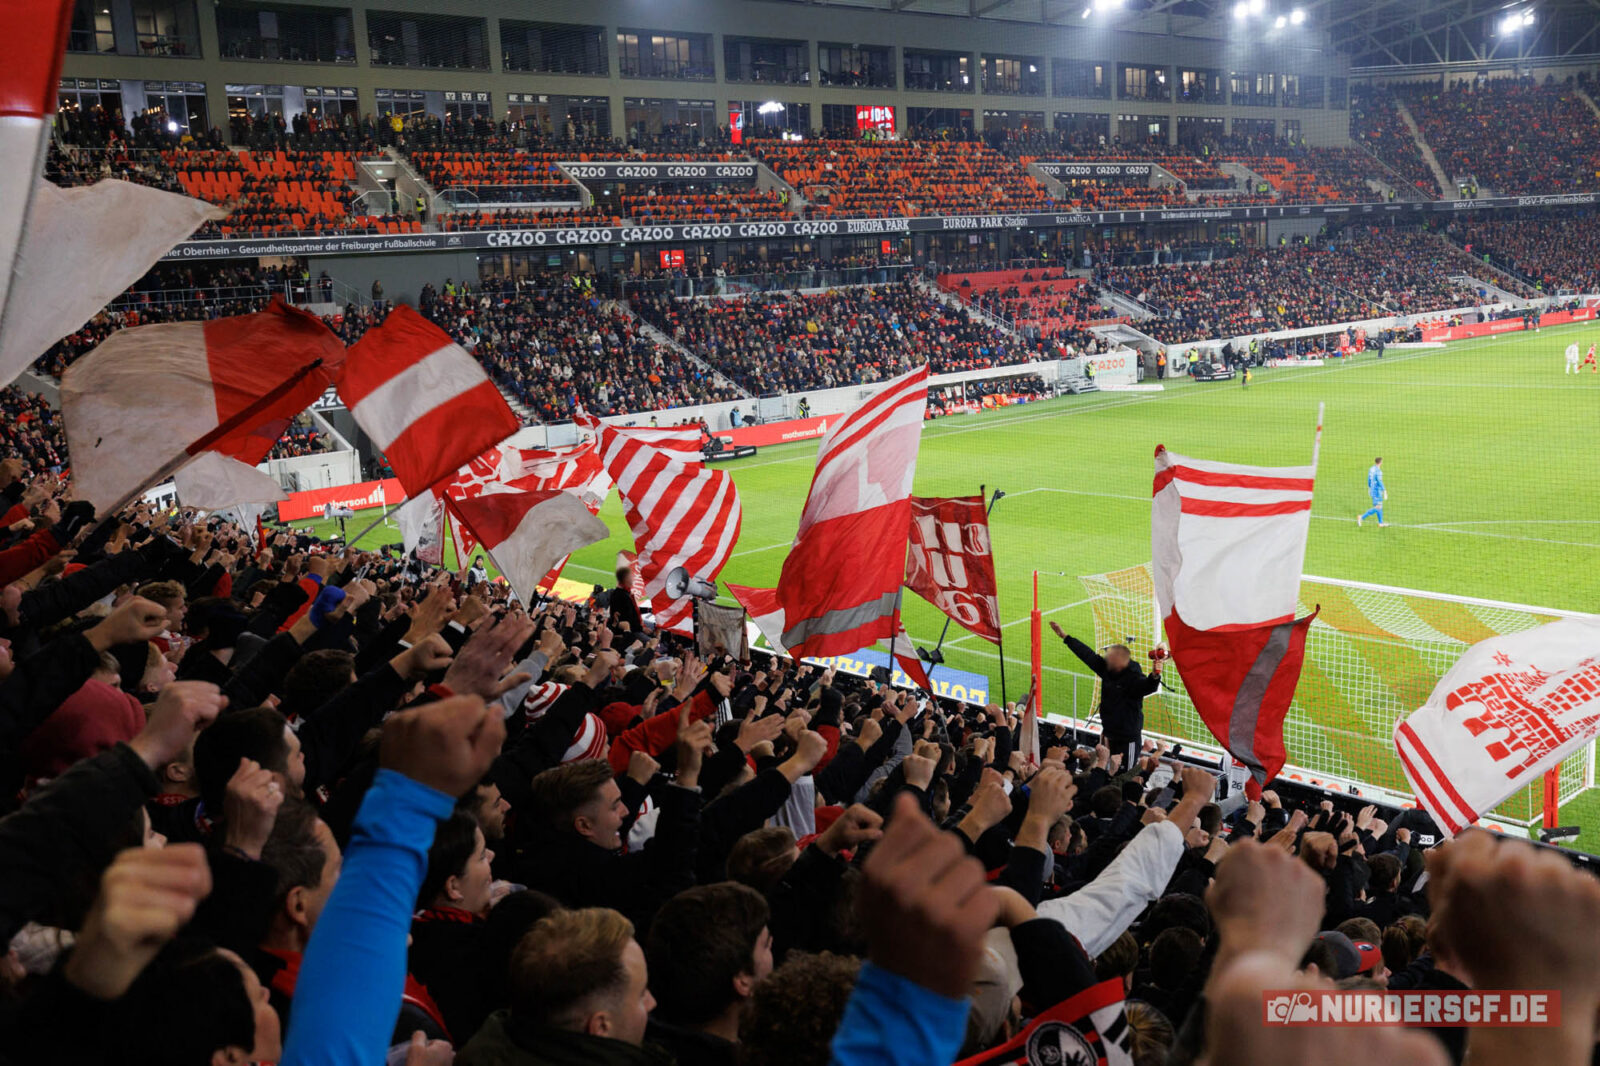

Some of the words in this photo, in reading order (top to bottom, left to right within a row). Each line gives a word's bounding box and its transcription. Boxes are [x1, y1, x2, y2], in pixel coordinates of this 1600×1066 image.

[616, 167, 658, 177] CAZOO
[667, 166, 707, 177] CAZOO
[716, 166, 753, 176] CAZOO
[1065, 166, 1091, 175] CAZOO
[1096, 166, 1121, 175] CAZOO
[1125, 166, 1149, 174] CAZOO
[1518, 195, 1596, 206] BGV-Familienblock
[847, 220, 883, 233] EUROPA
[886, 219, 910, 231] PARK
[942, 217, 978, 229] EUROPA
[980, 216, 1003, 228] PARK
[1004, 215, 1028, 227] Stadion
[486, 231, 546, 247] CAZOO
[556, 229, 612, 244] CAZOO
[621, 227, 674, 241] CAZOO
[682, 225, 732, 239] CAZOO
[739, 223, 786, 237] CAZOO
[793, 222, 838, 235] CAZOO
[183, 246, 230, 256] Oberrhein
[238, 243, 323, 254] Gesundheitspartner
[325, 242, 340, 250] der
[341, 240, 383, 251] Freiburger
[384, 238, 436, 249] Fußballschule
[1231, 780, 1243, 791] 26
